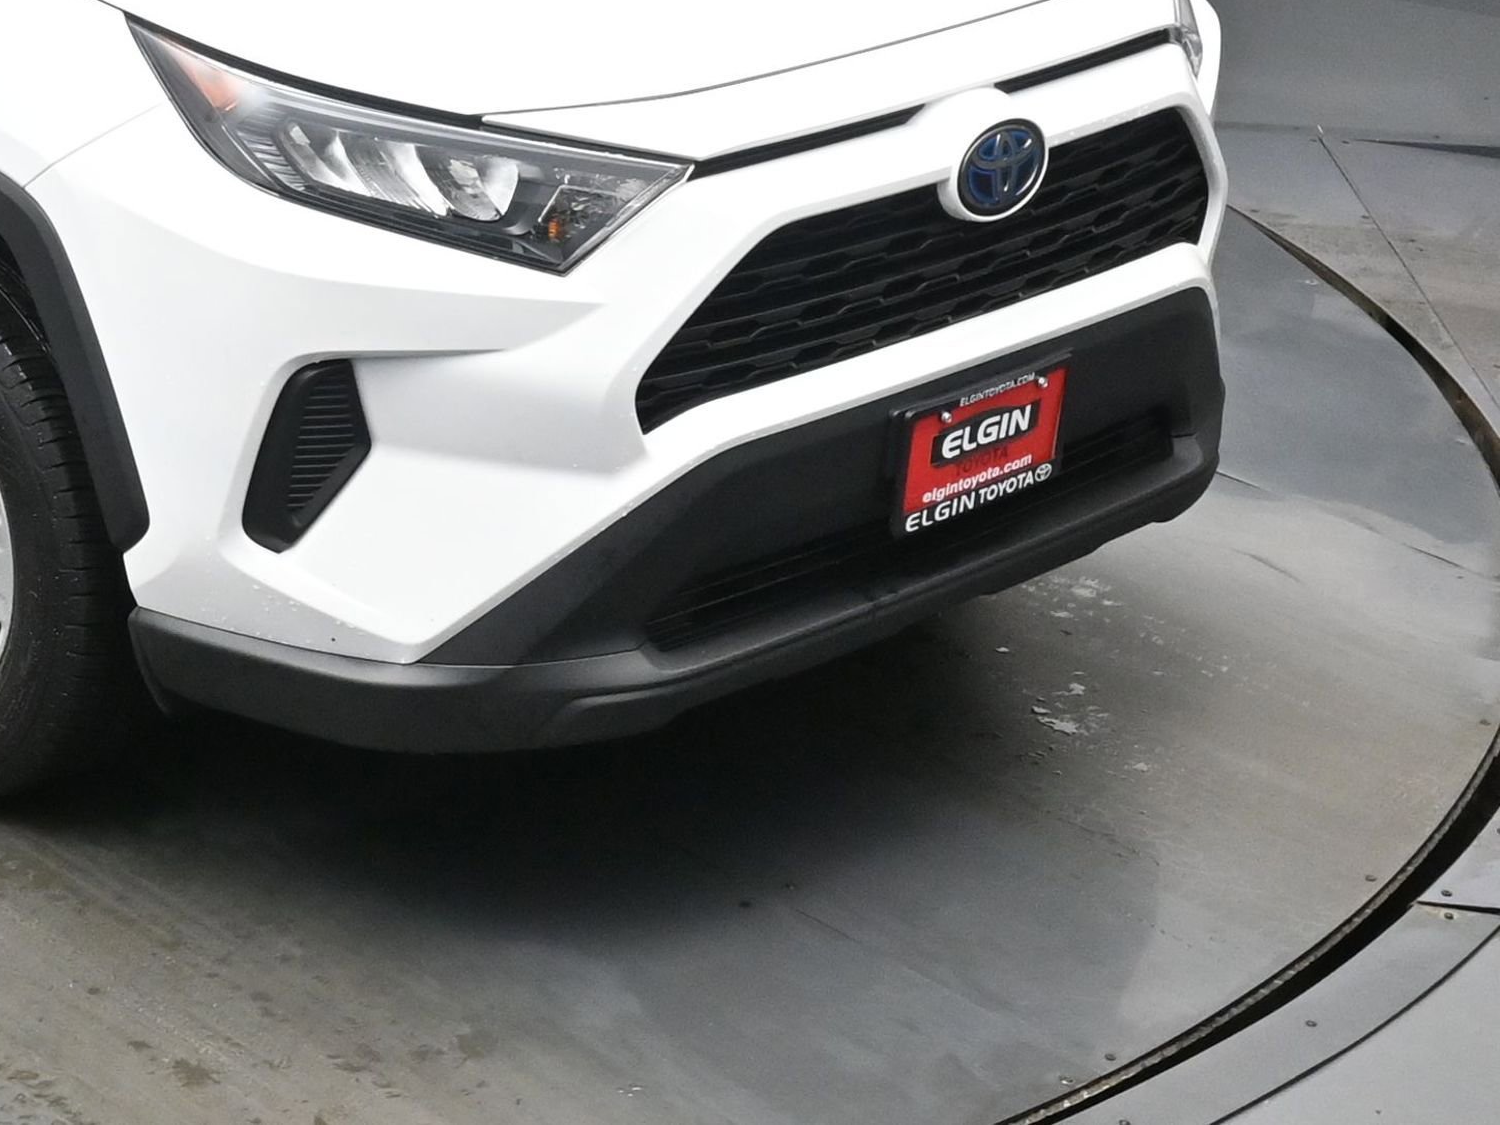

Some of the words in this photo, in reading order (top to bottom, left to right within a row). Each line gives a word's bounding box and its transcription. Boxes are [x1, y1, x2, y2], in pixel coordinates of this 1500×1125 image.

[959, 372, 1035, 407] ELGINTOYOTA.COM
[941, 405, 1032, 459] ELGIN
[905, 491, 975, 532] ELGIN
[979, 471, 1034, 504] TOYOTA
[922, 454, 1032, 503] elgintoyota.com
